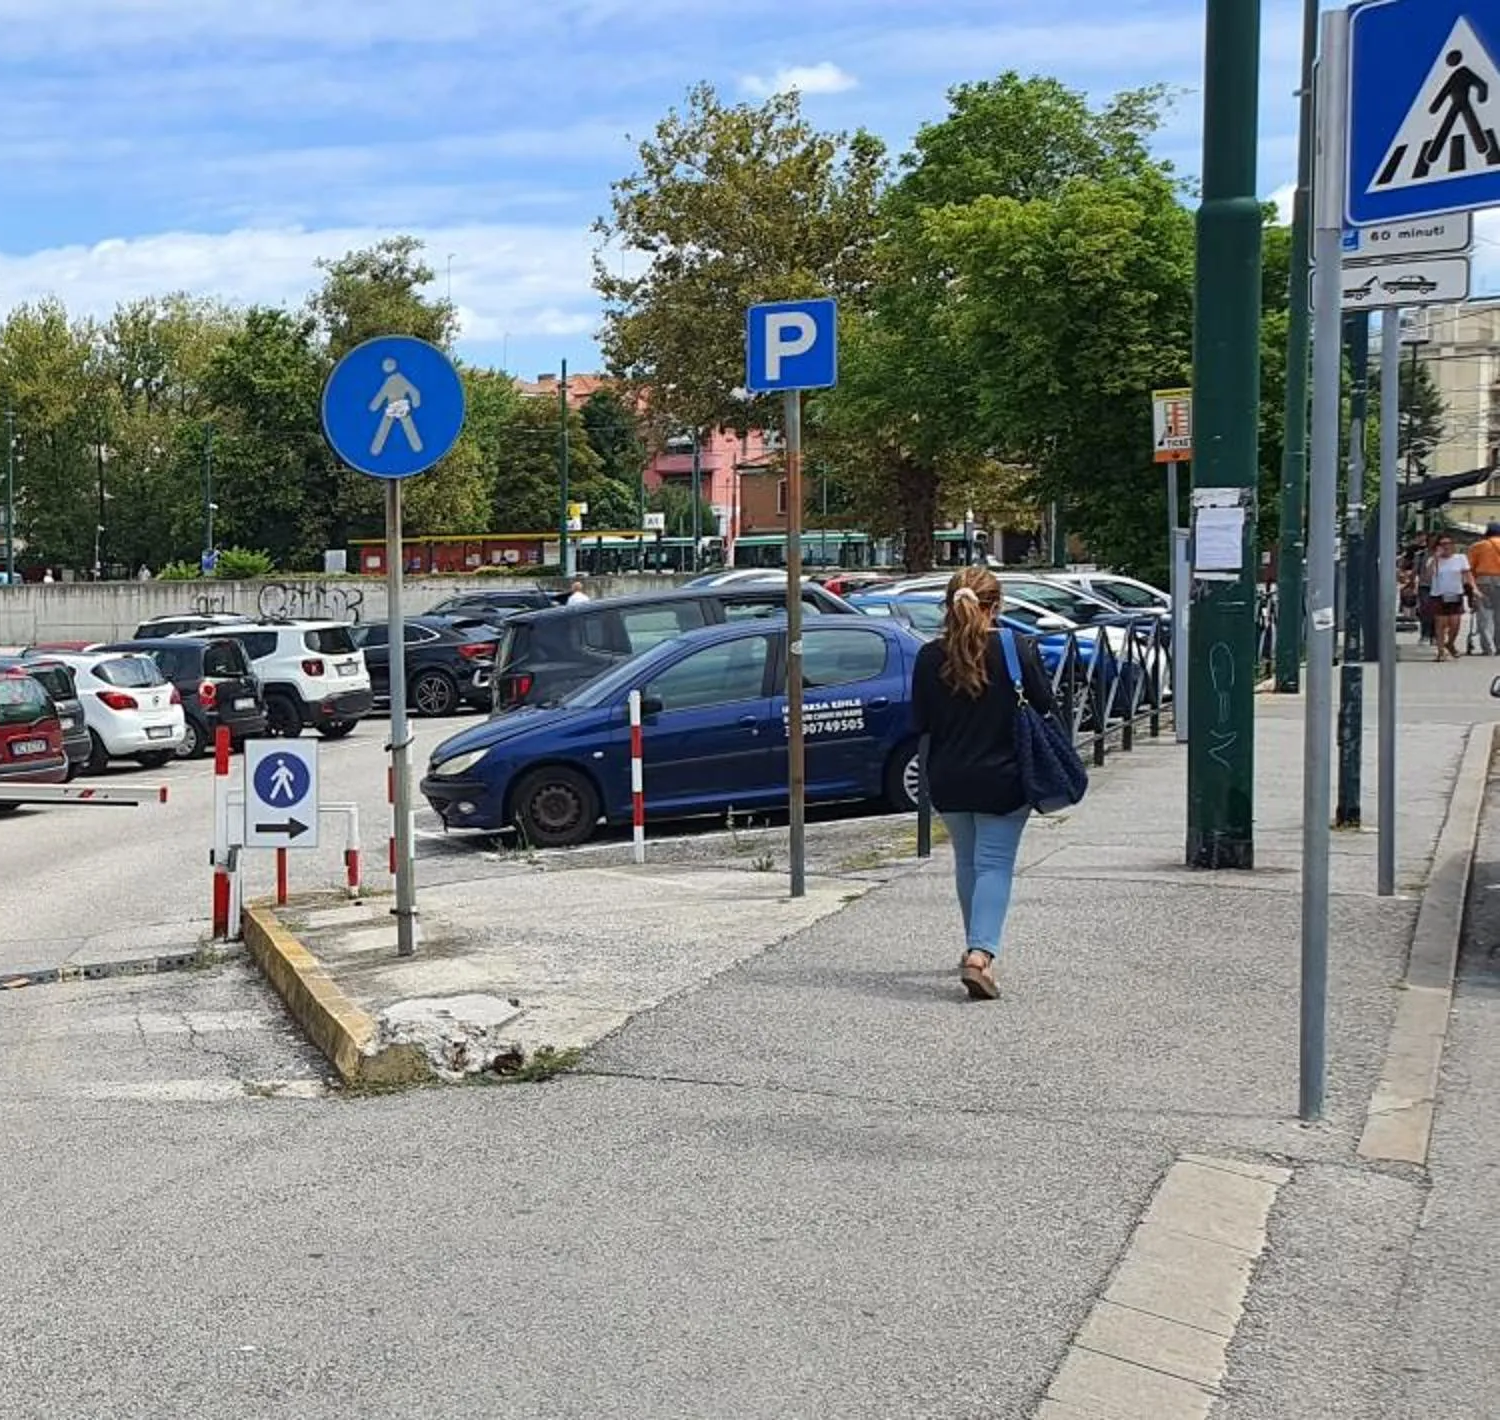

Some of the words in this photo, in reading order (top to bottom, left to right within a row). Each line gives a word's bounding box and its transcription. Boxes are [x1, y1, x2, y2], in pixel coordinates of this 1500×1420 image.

[1369, 231, 1391, 242] 60
[1397, 225, 1445, 239] minuti
[765, 311, 817, 381] P
